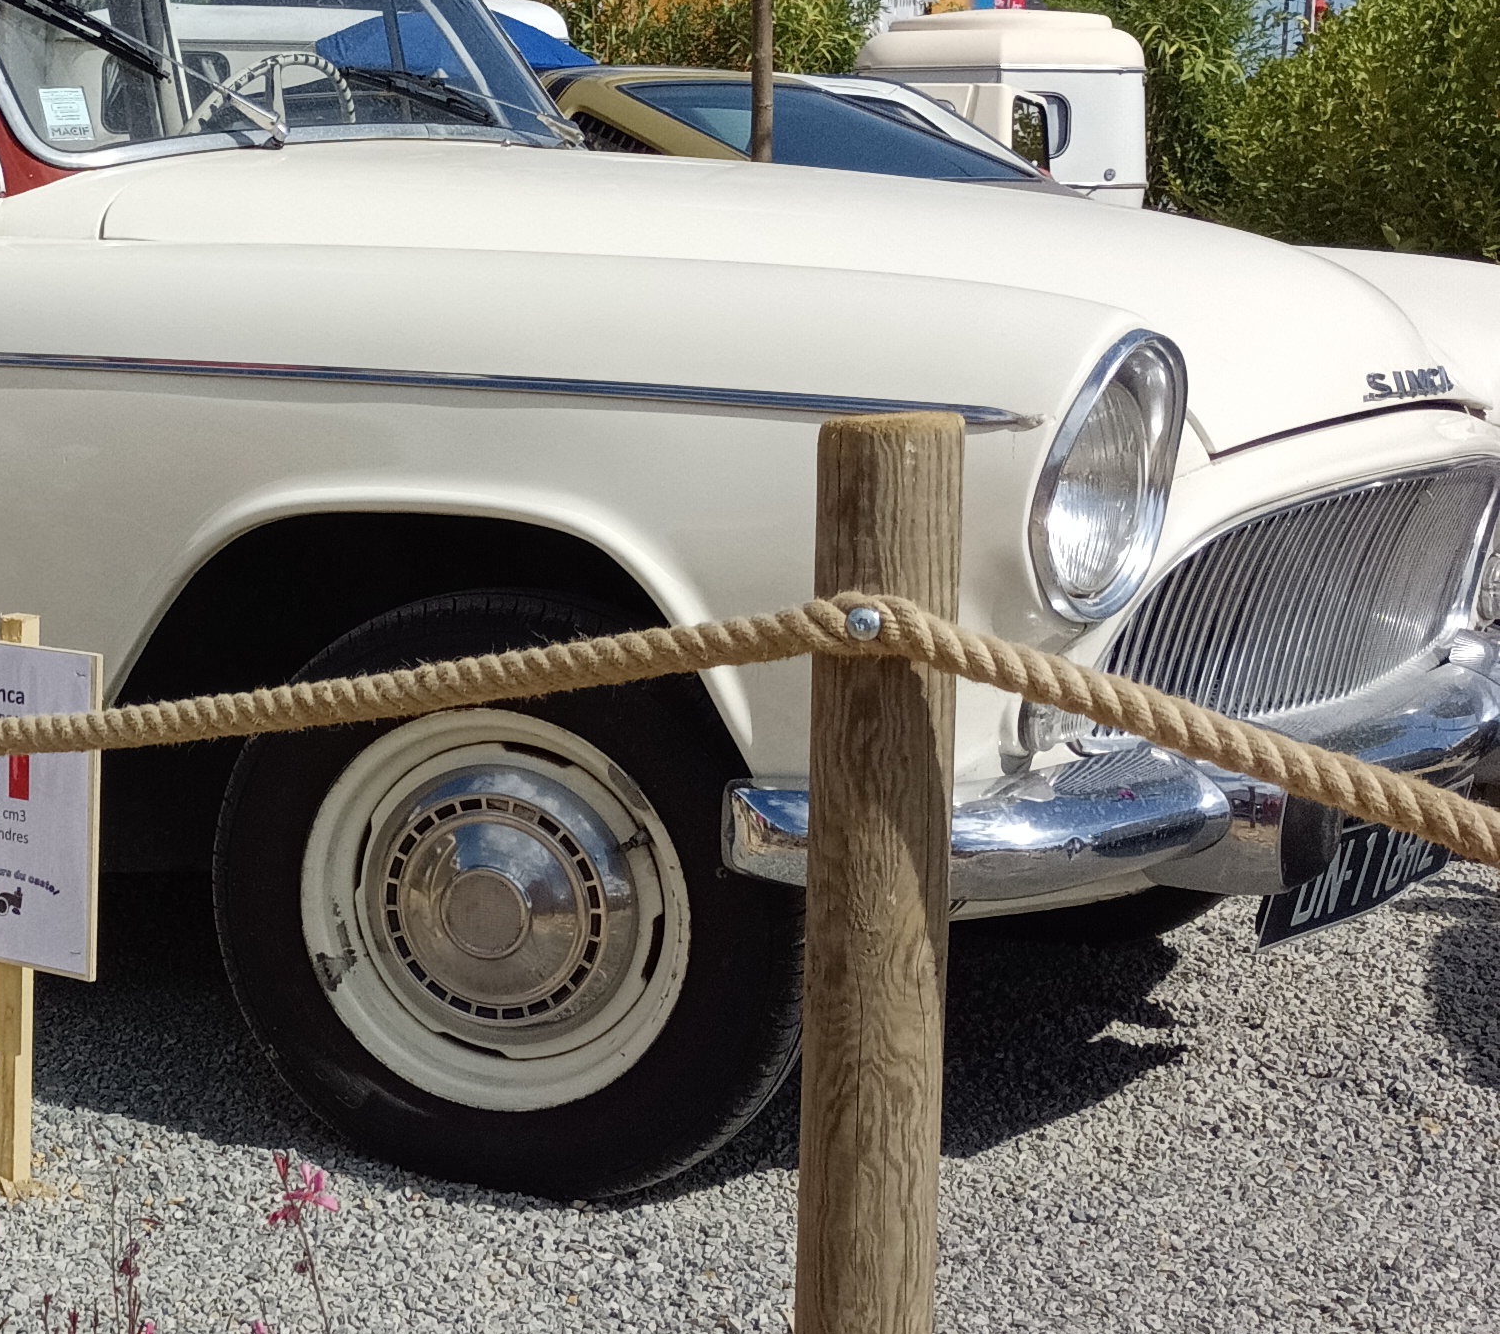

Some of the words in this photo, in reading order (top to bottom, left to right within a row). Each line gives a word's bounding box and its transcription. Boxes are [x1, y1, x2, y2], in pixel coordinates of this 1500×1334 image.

[50, 126, 90, 137] MACIF
[2, 809, 27, 823] cm3
[13, 869, 27, 881] du
